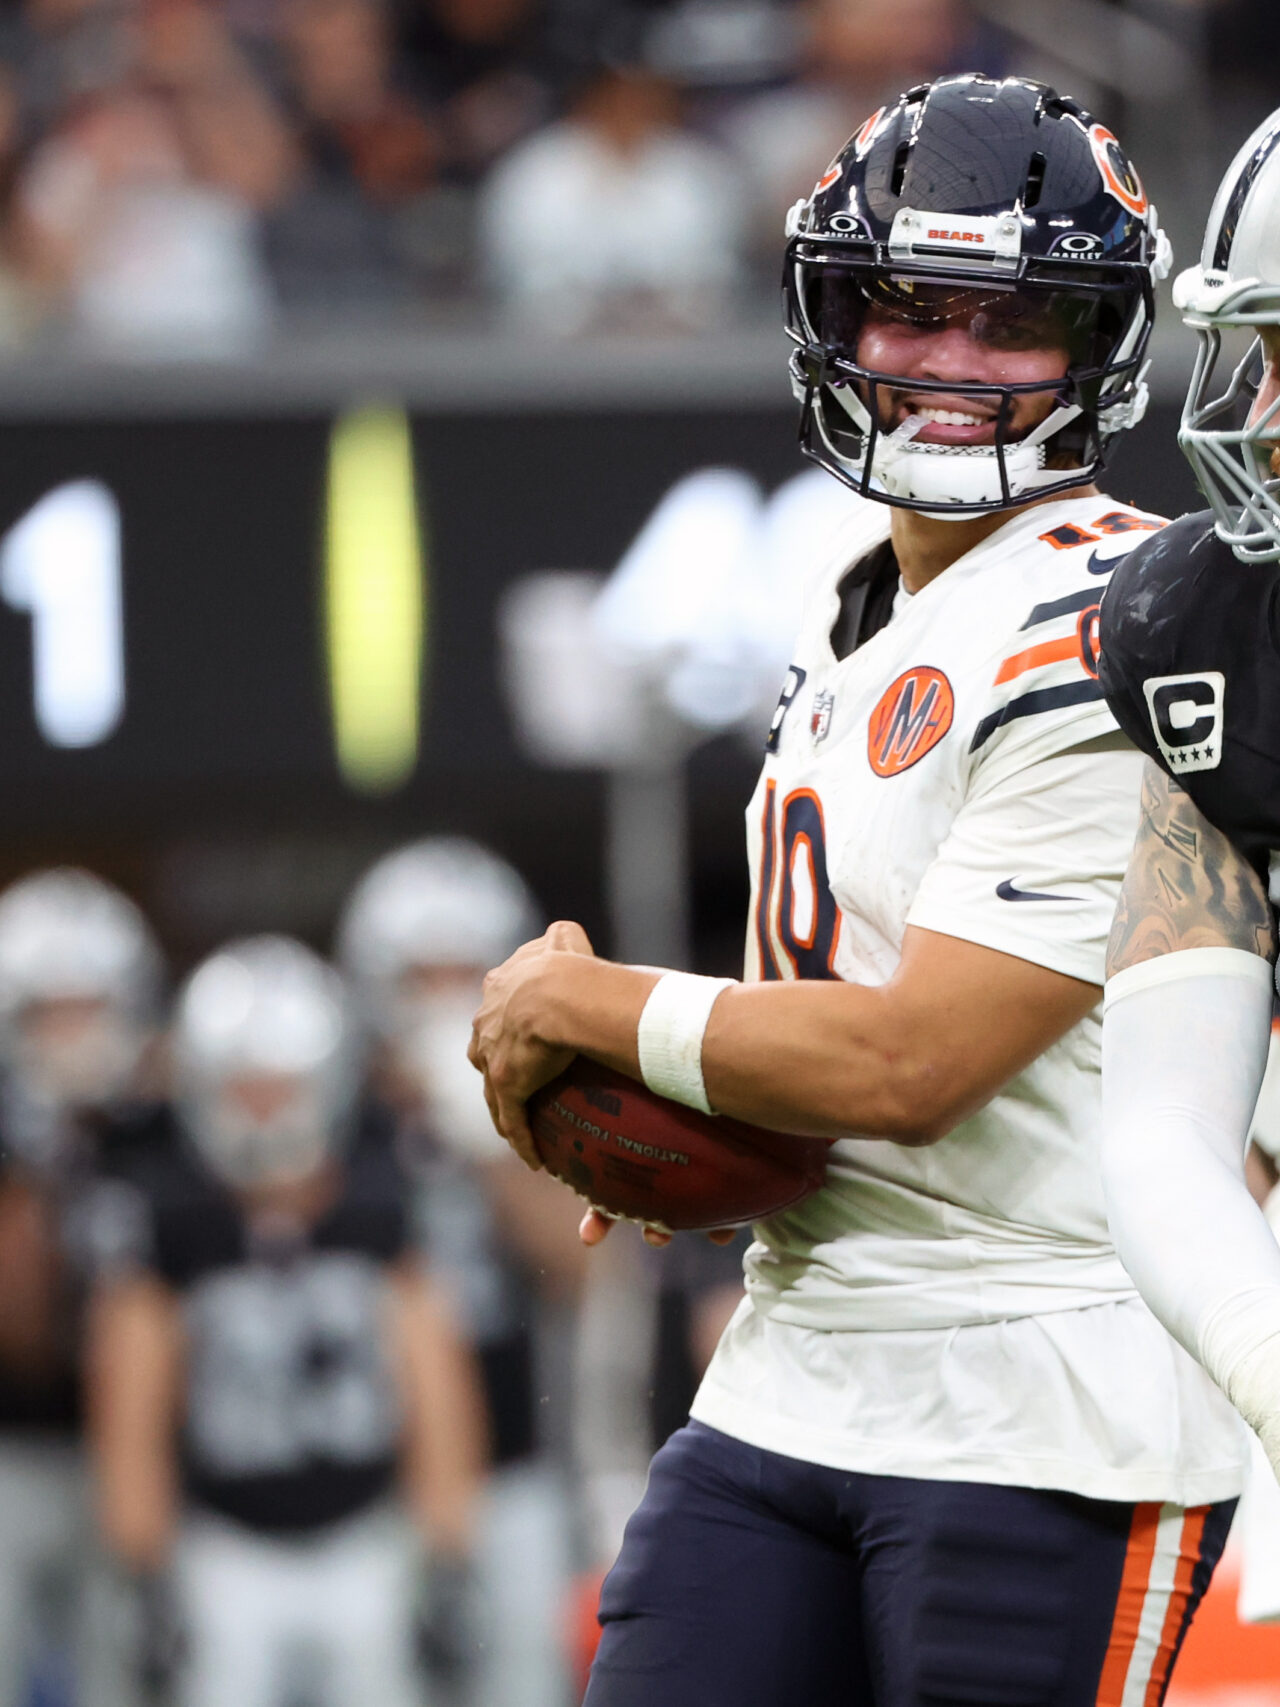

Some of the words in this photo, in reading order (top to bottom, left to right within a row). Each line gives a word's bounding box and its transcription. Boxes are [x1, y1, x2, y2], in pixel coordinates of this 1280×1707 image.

[928, 230, 984, 243] BEARS
[1051, 252, 1103, 260] OAKLEY
[1153, 681, 1215, 748] C
[615, 1135, 690, 1166] NATIONAL
